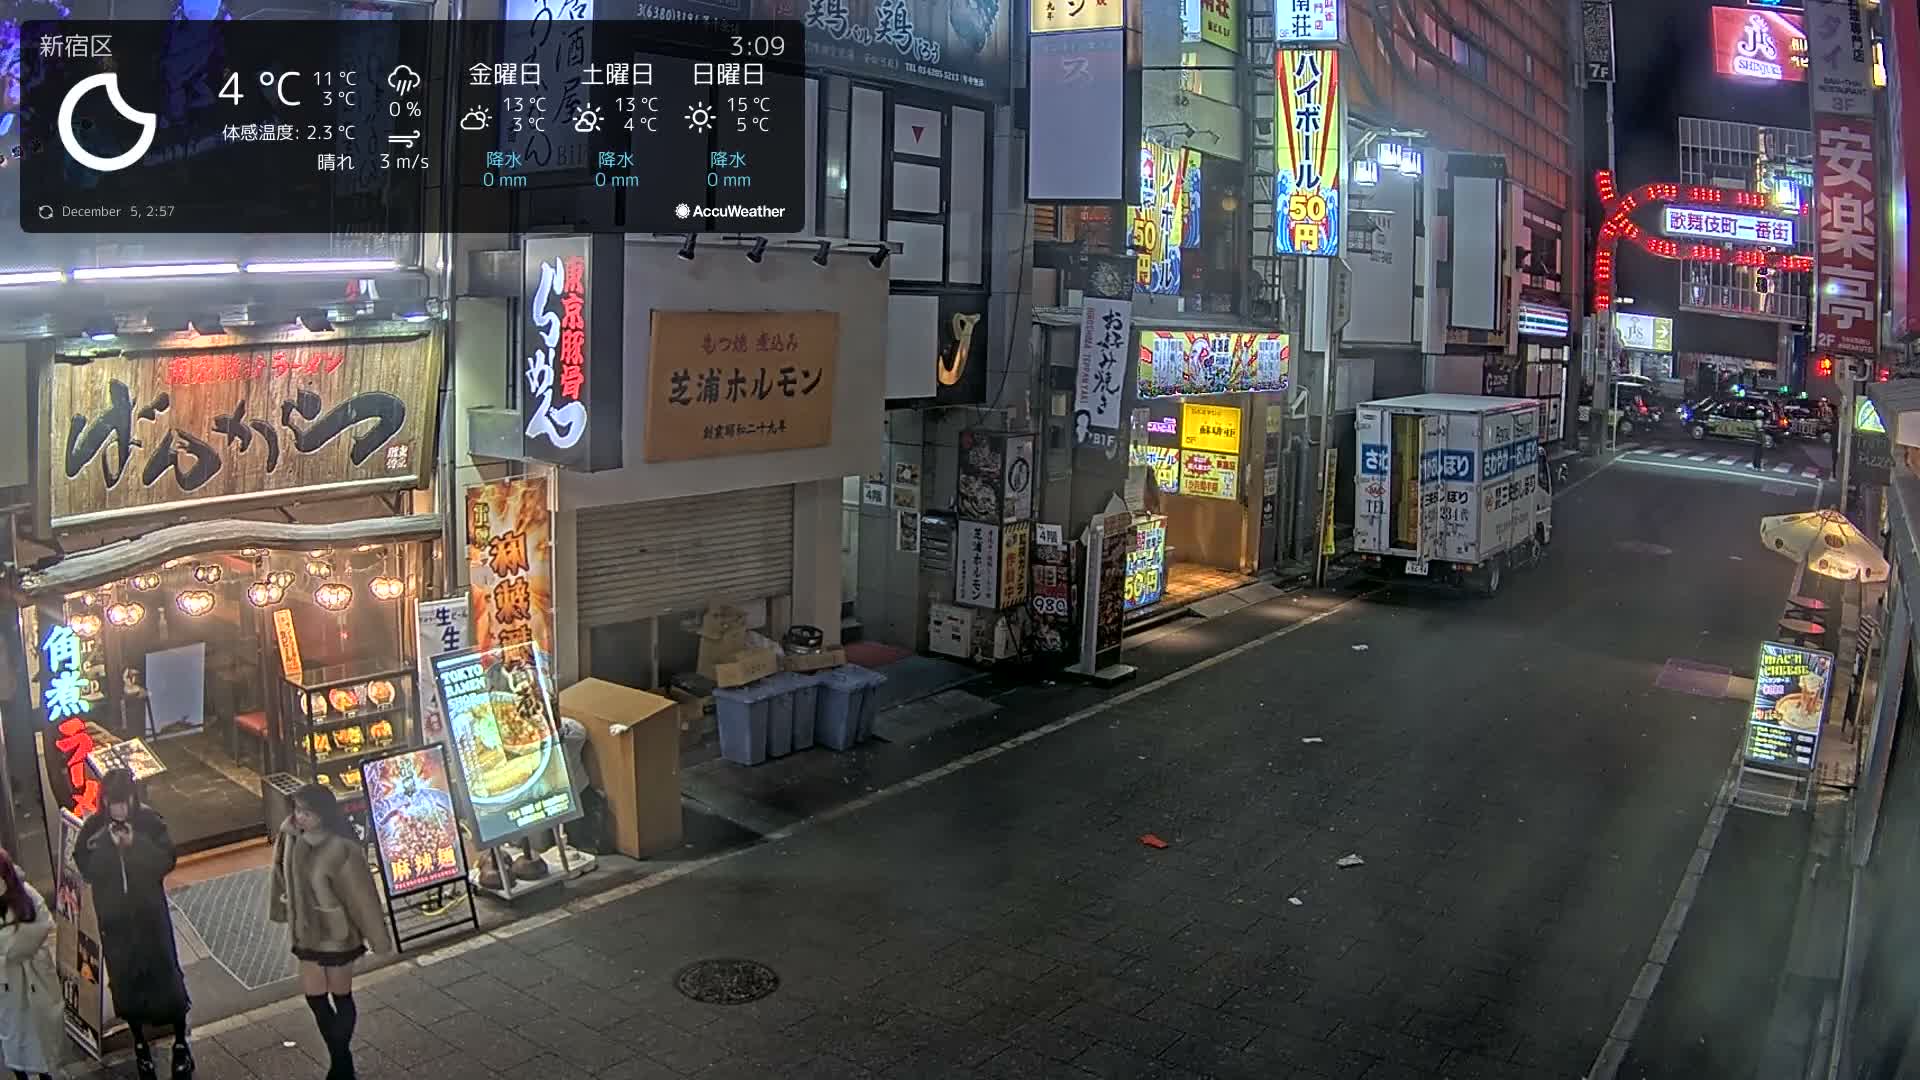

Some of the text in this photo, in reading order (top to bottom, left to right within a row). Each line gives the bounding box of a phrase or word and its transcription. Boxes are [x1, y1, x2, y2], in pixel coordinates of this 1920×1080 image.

[1589, 63, 1608, 78] 7F
[1295, 53, 1320, 190] ハイボール
[1669, 211, 1789, 242] 歌舞伎町一番街
[1818, 126, 1877, 329] 安楽亭
[561, 255, 586, 400] 東京豚骨
[1818, 333, 1835, 346] 2F
[668, 366, 824, 406] 芝浦ホルモン
[1039, 530, 1058, 543] 4階
[440, 663, 484, 686] TOKYO
[1764, 664, 1809, 677] CHEESE
[444, 677, 487, 699] RAMEN
